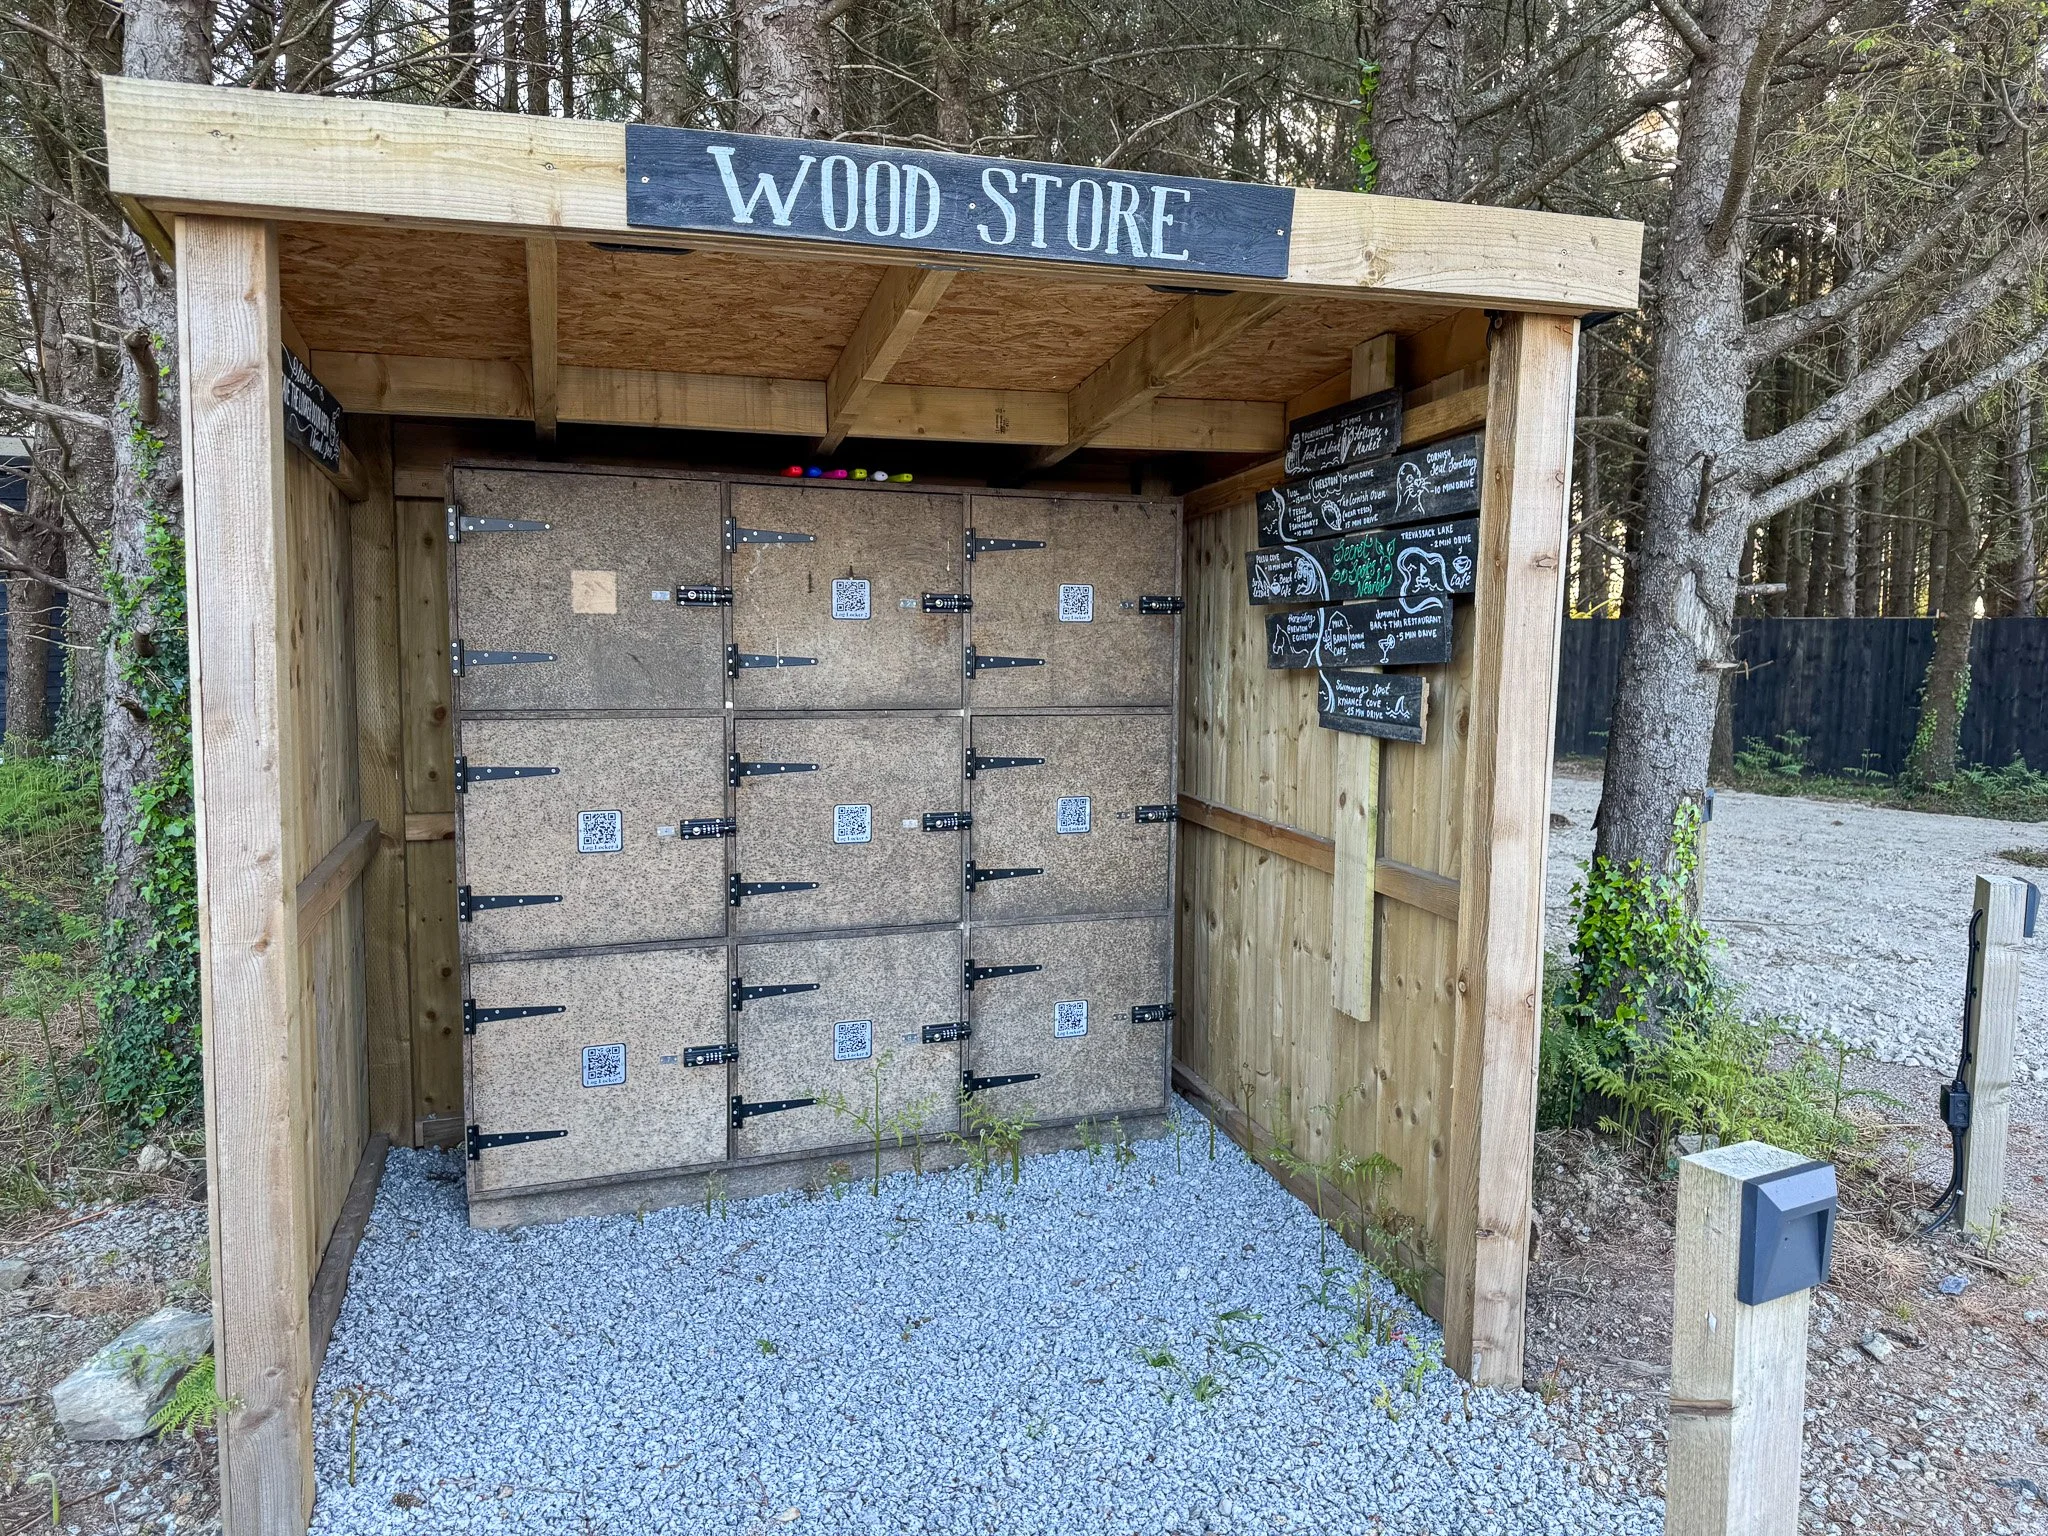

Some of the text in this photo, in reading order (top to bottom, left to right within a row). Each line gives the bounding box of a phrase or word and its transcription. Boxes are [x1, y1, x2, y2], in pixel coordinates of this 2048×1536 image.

[706, 145, 1192, 261] WOOD STORE
[1354, 424, 1382, 441] Artisan
[1353, 434, 1382, 457] Market
[1427, 449, 1451, 464] CORNISH
[1430, 459, 1447, 476] Seal
[1315, 476, 1338, 490] HELSTON
[1360, 469, 1374, 478] DRIVE
[1442, 483, 1455, 492] MIN
[1455, 478, 1475, 490] DRIVE
[1336, 490, 1386, 507] The Cornish Oven
[1292, 507, 1306, 516] TESCO
[1352, 519, 1362, 527] MIN
[1363, 514, 1378, 525] DRIVE
[1401, 524, 1454, 540] TREVASSACK LAKE
[1438, 538, 1452, 546] MIN
[1454, 534, 1472, 544] DRIVE
[1333, 533, 1373, 566] Secret
[1270, 554, 1280, 562] COVE
[1281, 560, 1292, 570] DRIVE
[1279, 572, 1292, 584] Beach
[1355, 569, 1388, 598] Nearby
[1450, 572, 1472, 588] Café
[1332, 620, 1344, 628] MILK
[1370, 620, 1382, 630] BAR
[1388, 620, 1402, 629] THAI
[1404, 615, 1442, 626] RESTAURANT
[1332, 634, 1348, 644] BARN
[1404, 631, 1416, 640] MIN
[1418, 629, 1438, 638] DRIVE
[1333, 647, 1346, 656] CAFE
[1351, 642, 1366, 650] DRIVE
[1336, 680, 1392, 698] Swimming Spot
[1338, 696, 1382, 708] KYNANCE COVE
[1355, 708, 1365, 718] MIN
[1366, 710, 1383, 720] DRIVE
